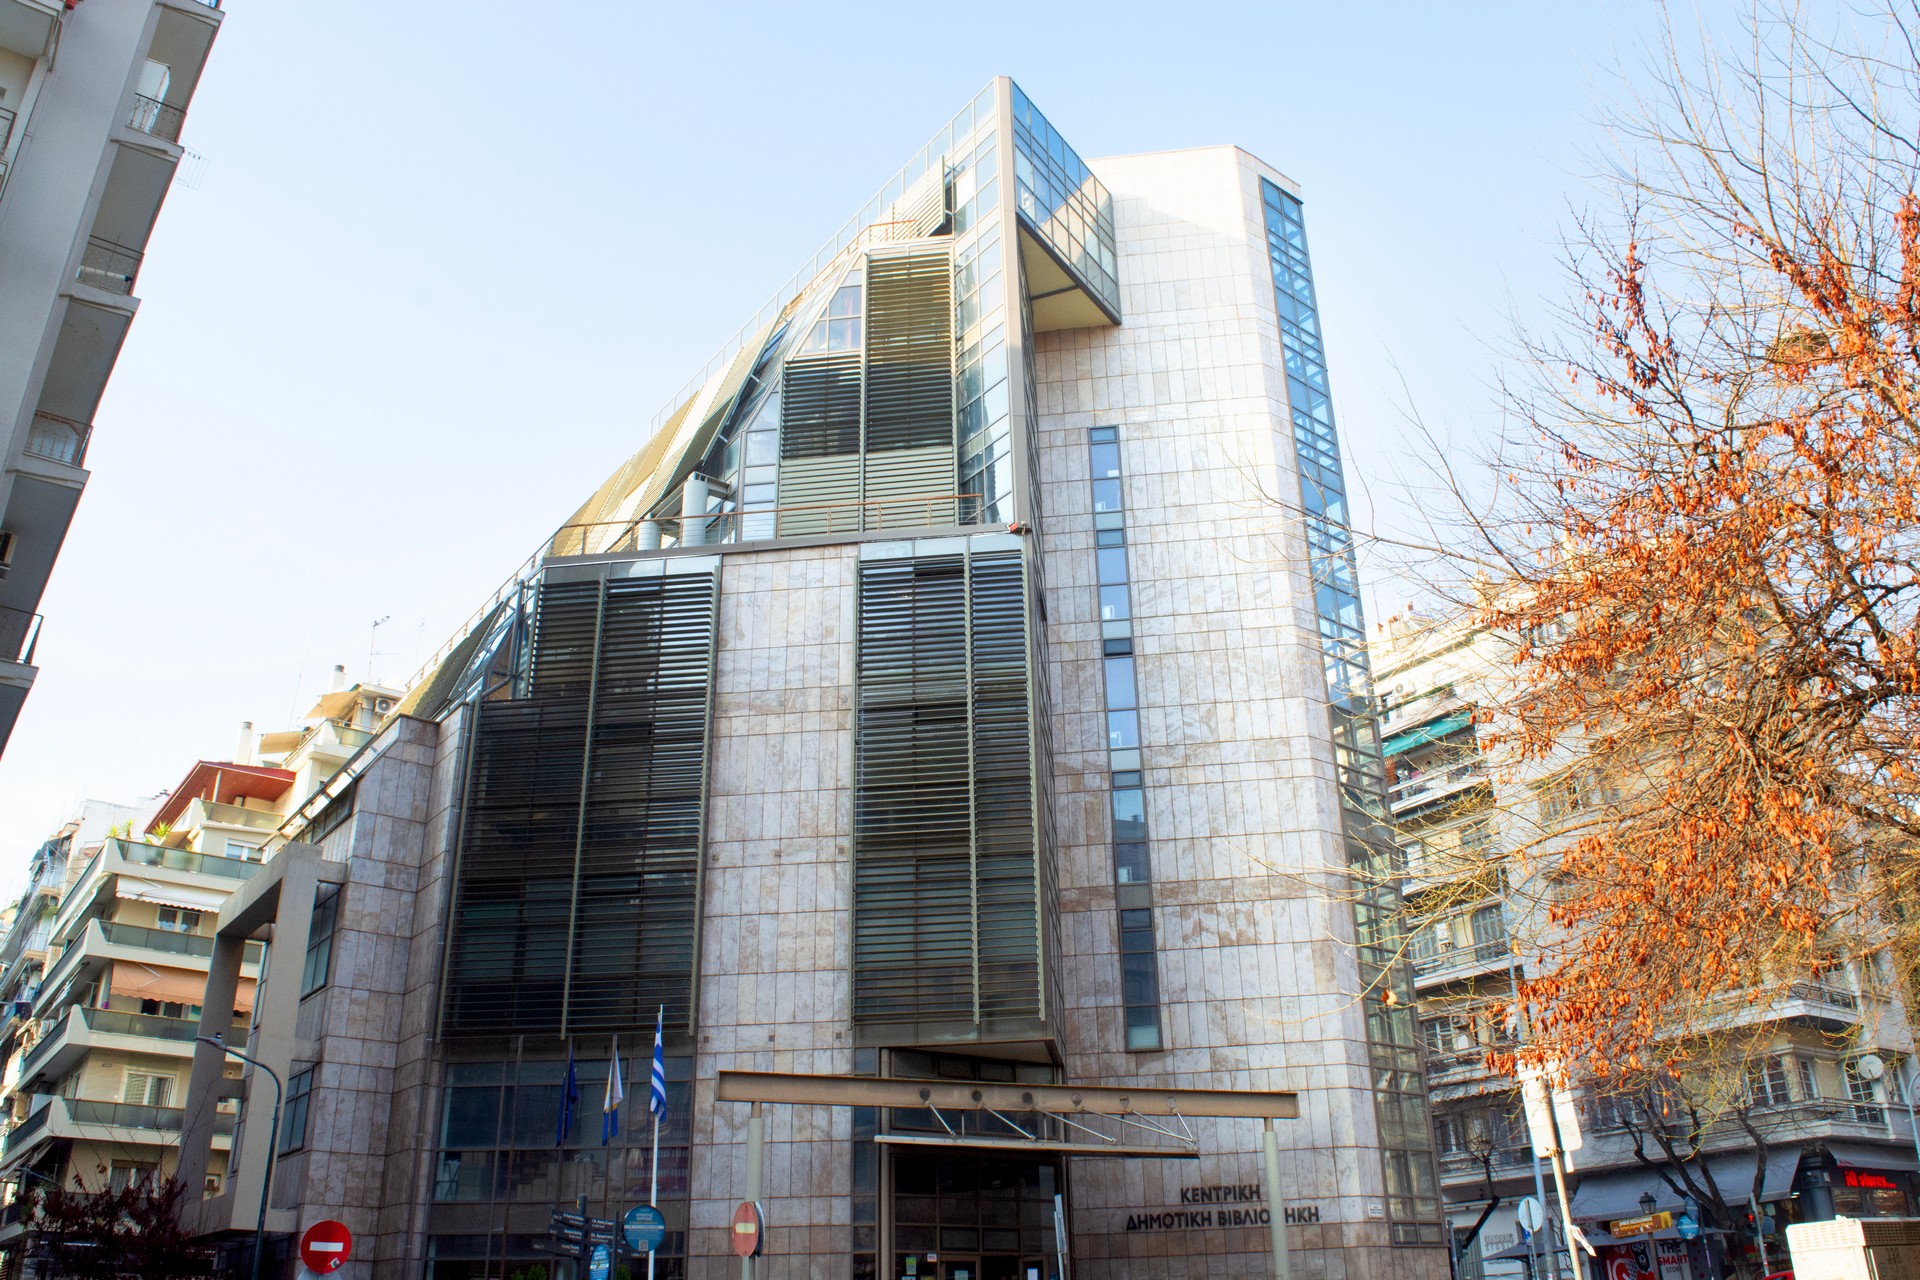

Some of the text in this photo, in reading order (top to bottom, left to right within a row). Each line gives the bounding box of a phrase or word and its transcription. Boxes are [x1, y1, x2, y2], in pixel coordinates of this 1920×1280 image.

[1180, 1184, 1261, 1203] ΚΕΝΤΡΙΚΗ
[1126, 1206, 1320, 1231] ΔΗΜΟΤΙΚΗ ΒΙΒΛΙΟΗΚΗ
[1659, 1254, 1688, 1265] SMART
